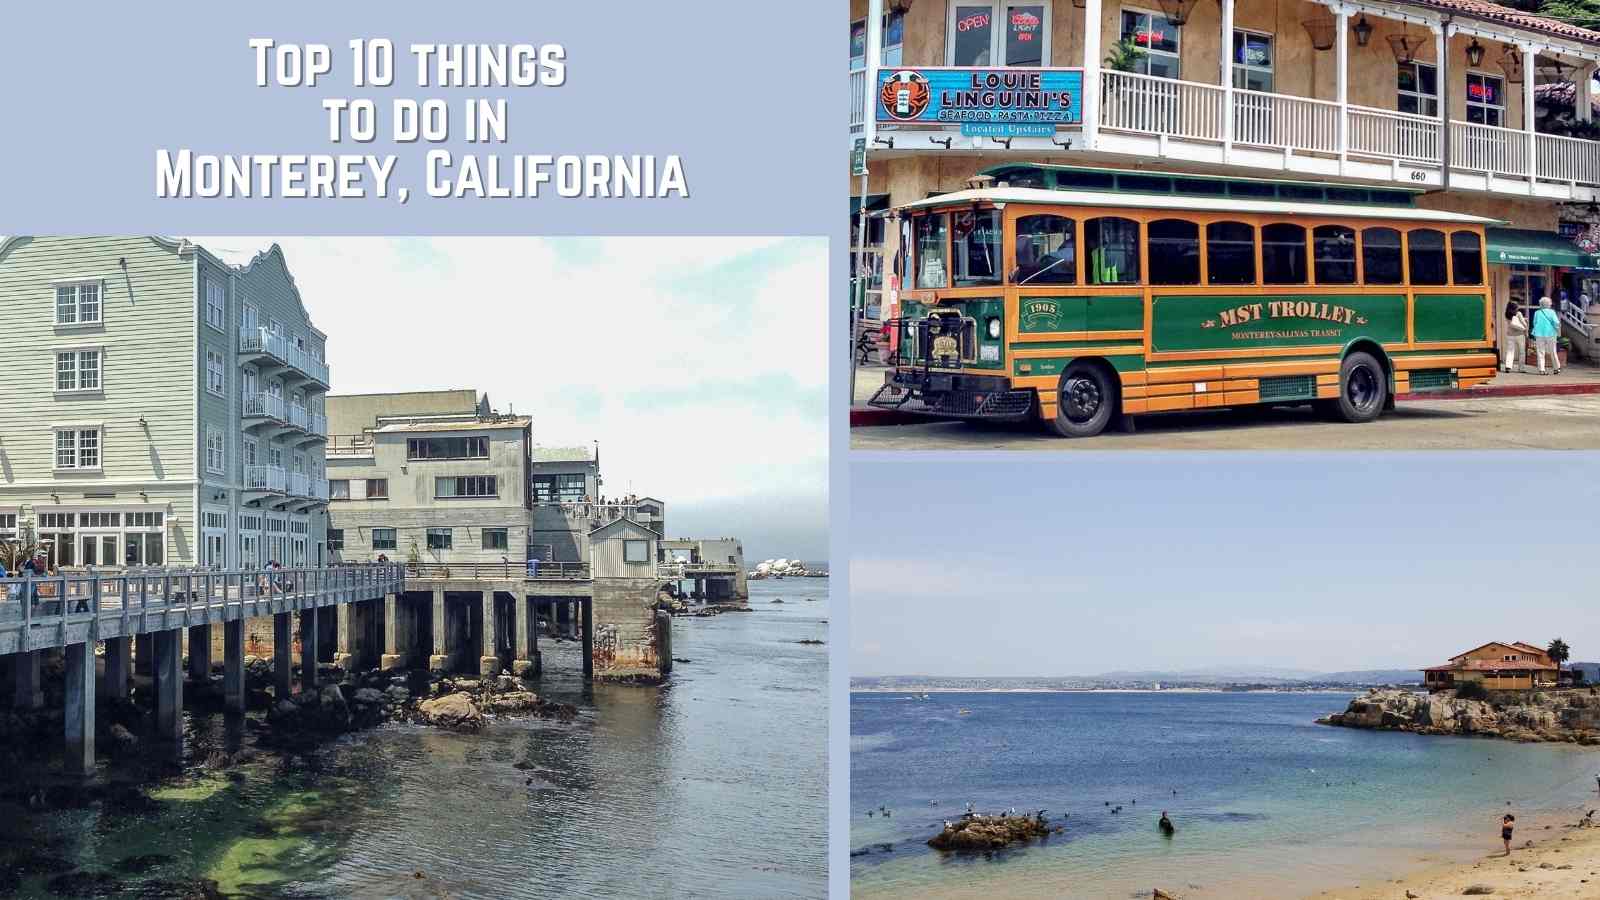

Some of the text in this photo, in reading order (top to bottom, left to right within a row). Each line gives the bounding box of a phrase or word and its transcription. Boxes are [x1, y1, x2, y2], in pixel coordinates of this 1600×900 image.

[958, 14, 989, 32] OPEN
[971, 72, 1041, 89] LOUIE
[942, 90, 1071, 108] LINGUINI'S
[966, 123, 1052, 136] Located Upstairs
[1411, 170, 1426, 181] 660
[1030, 303, 1056, 313] 1905
[1219, 301, 1355, 328] MST TROLLEY
[1310, 329, 1342, 337] TRANSIT
